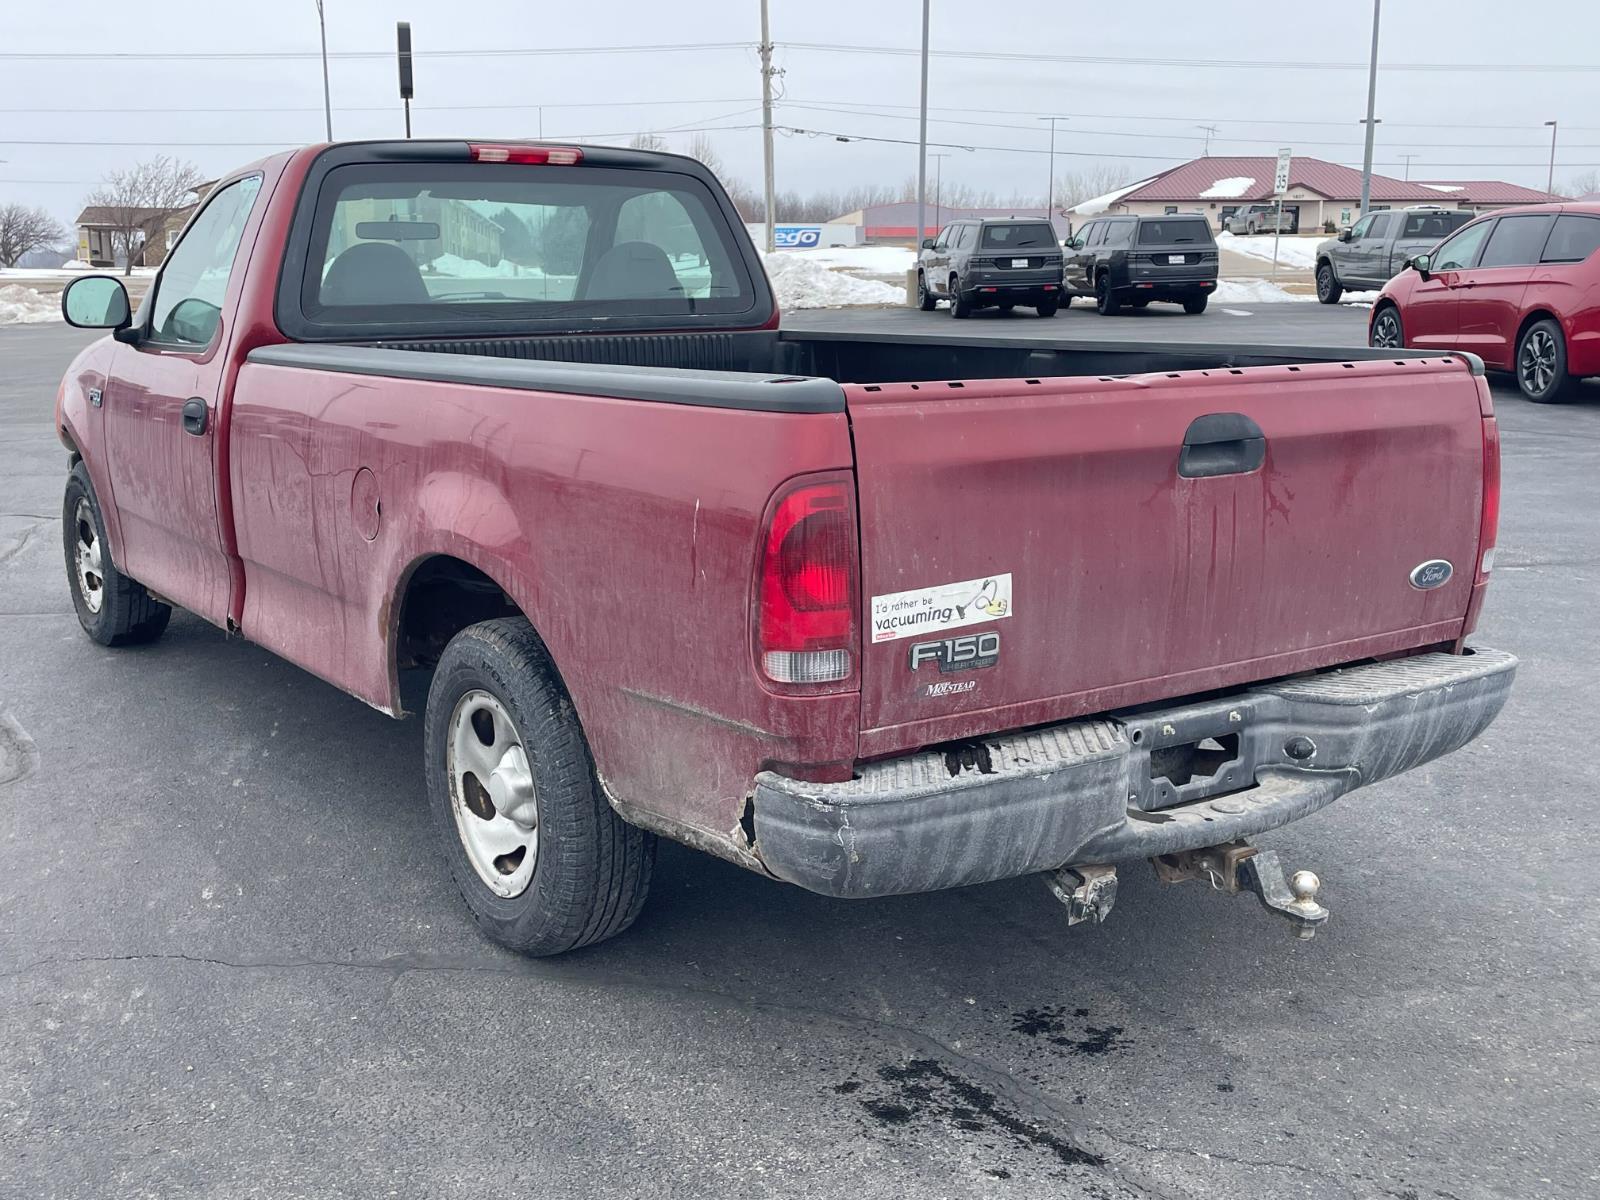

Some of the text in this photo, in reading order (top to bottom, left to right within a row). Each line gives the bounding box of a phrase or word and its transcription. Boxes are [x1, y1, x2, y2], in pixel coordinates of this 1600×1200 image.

[1276, 174, 1287, 189] 35
[1422, 566, 1445, 583] Ford
[876, 597, 933, 614] I'd rather be
[875, 606, 953, 631] vacuuming
